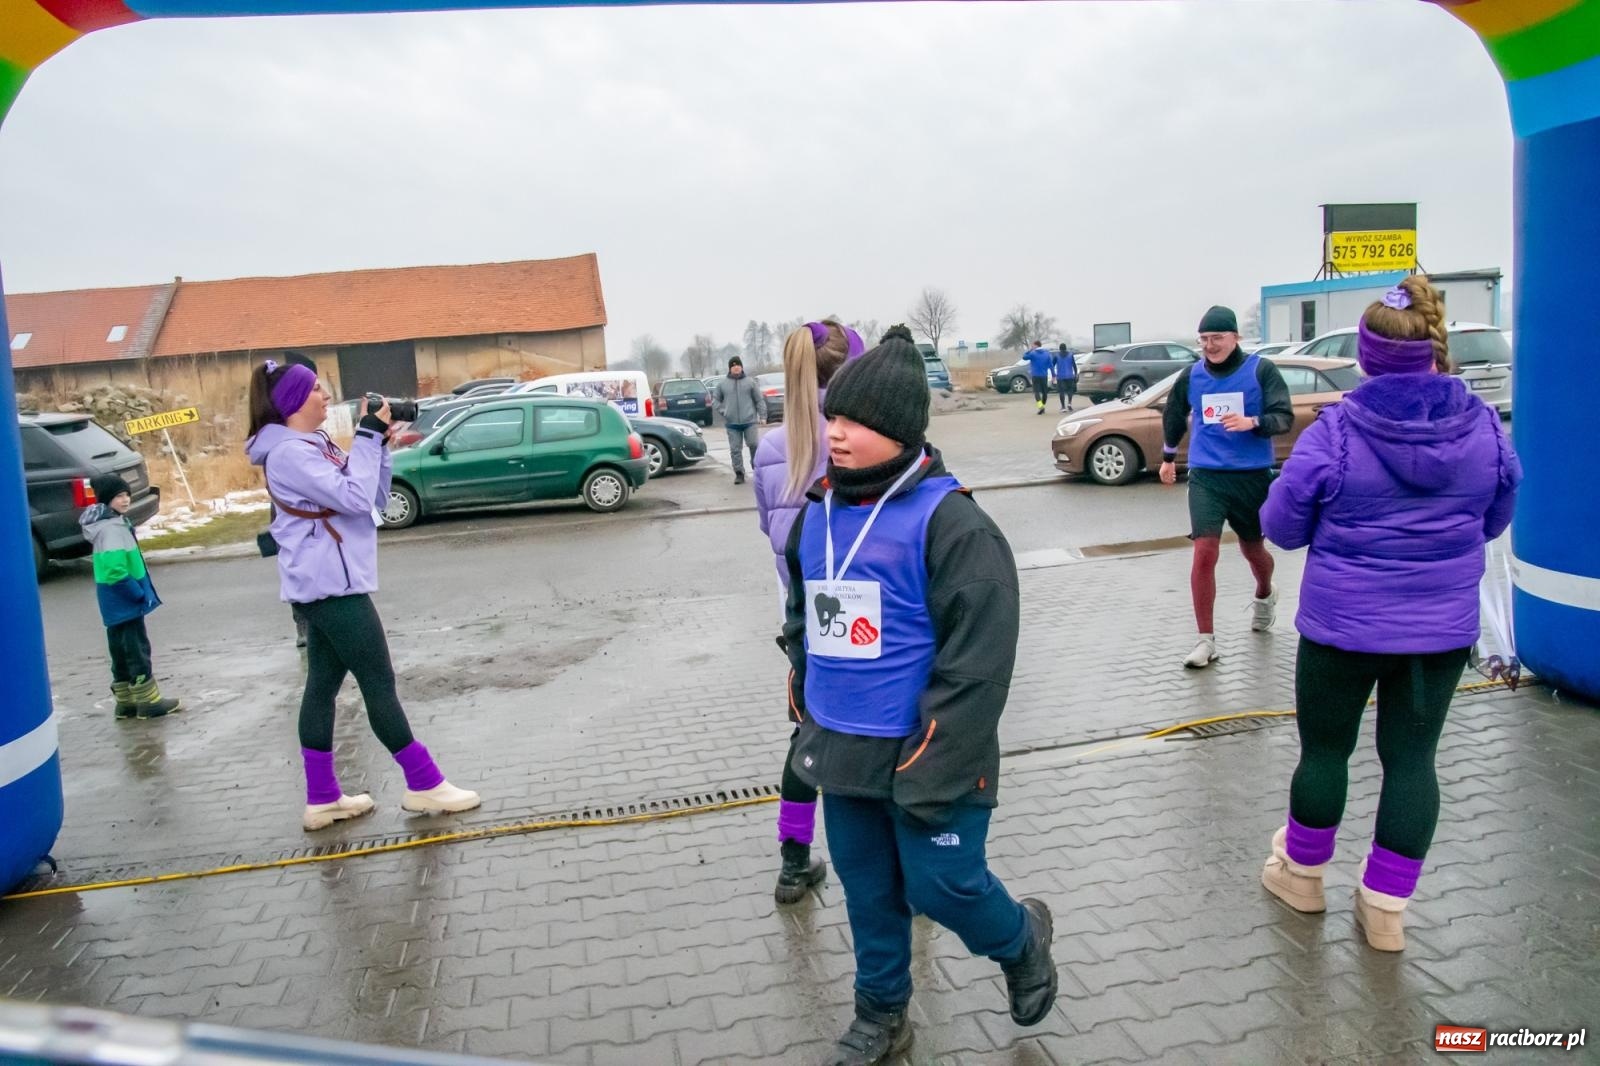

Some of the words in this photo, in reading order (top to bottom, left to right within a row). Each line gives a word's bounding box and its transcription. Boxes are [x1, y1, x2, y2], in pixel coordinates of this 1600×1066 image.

[1374, 233, 1402, 241] SZAMBA
[1332, 245, 1357, 259] 575
[1361, 244, 1385, 258] 792
[1389, 243, 1414, 257] 626
[126, 412, 182, 434] PARKING
